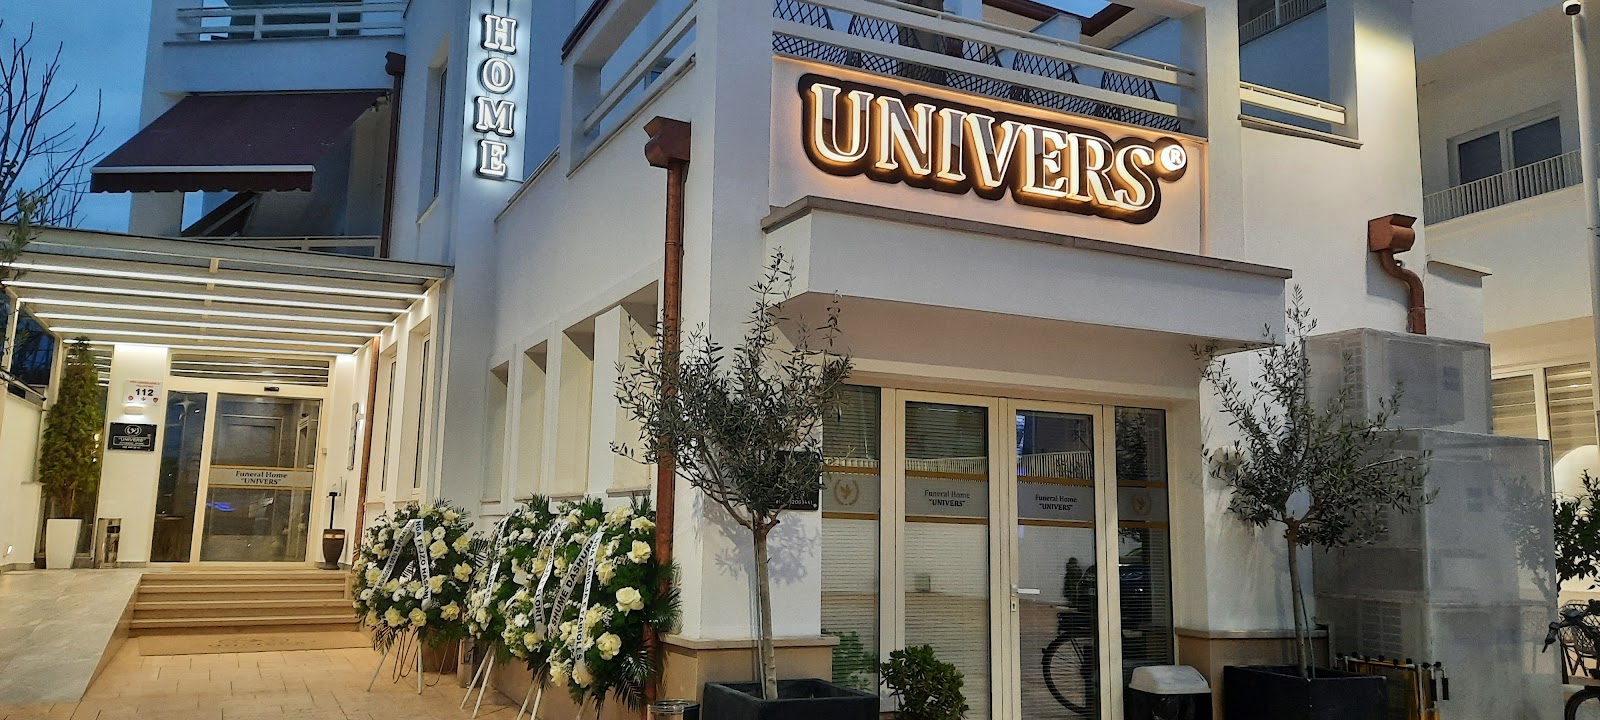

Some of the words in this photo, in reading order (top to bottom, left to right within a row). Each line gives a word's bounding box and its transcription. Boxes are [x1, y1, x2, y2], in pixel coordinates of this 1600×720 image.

[475, 14, 517, 178] HOME
[135, 388, 154, 397] 112
[235, 470, 263, 478] Funeral
[265, 471, 288, 479] Home
[924, 489, 950, 498] Funeral
[951, 490, 971, 499] Home
[1035, 493, 1058, 502] Funeral
[1059, 495, 1078, 503] Home
[928, 498, 966, 507] "UNIVERS"
[1039, 502, 1074, 511] "UNIVERS"
[416, 539, 426, 566] FEJZO
[534, 589, 543, 624] FLORIT
[551, 590, 569, 626] SHUME
